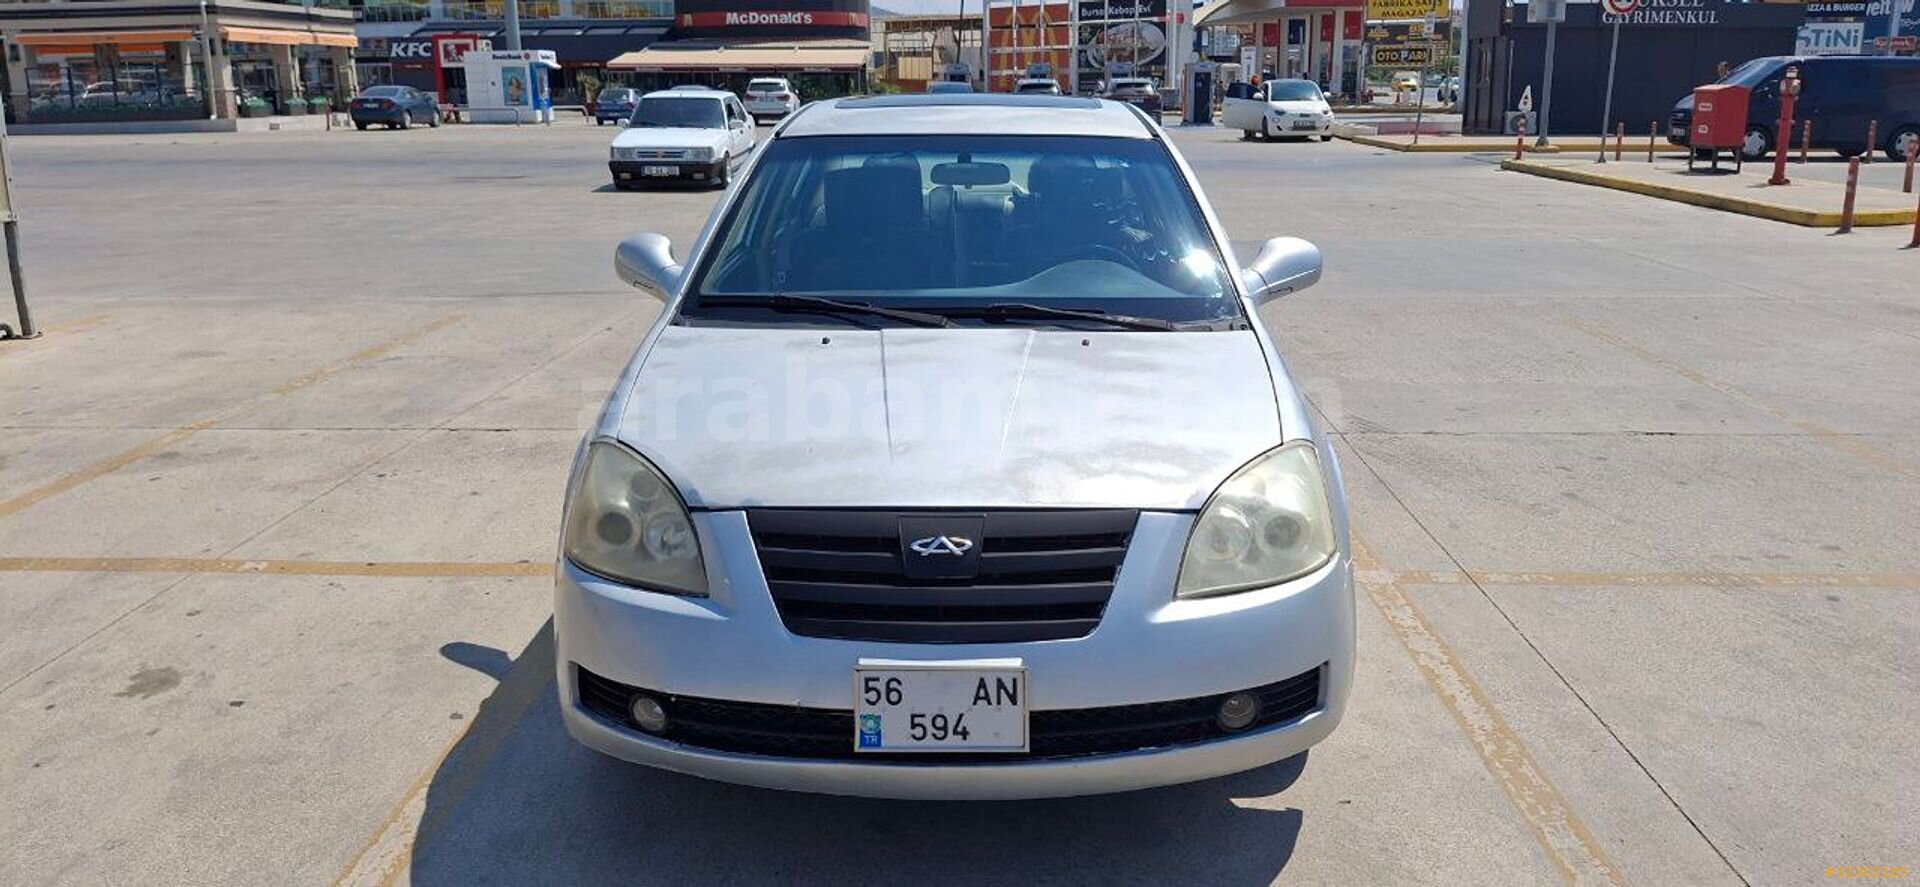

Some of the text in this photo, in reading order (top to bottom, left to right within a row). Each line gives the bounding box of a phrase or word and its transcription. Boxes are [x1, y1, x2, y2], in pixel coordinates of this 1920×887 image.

[1833, 3, 1866, 12] BURGER
[726, 12, 813, 25] McDonald's
[390, 41, 432, 57] KFC
[1377, 51, 1399, 61] OTO
[864, 677, 1019, 706] 56 AN
[909, 713, 970, 741] 594
[864, 735, 879, 745] TR
